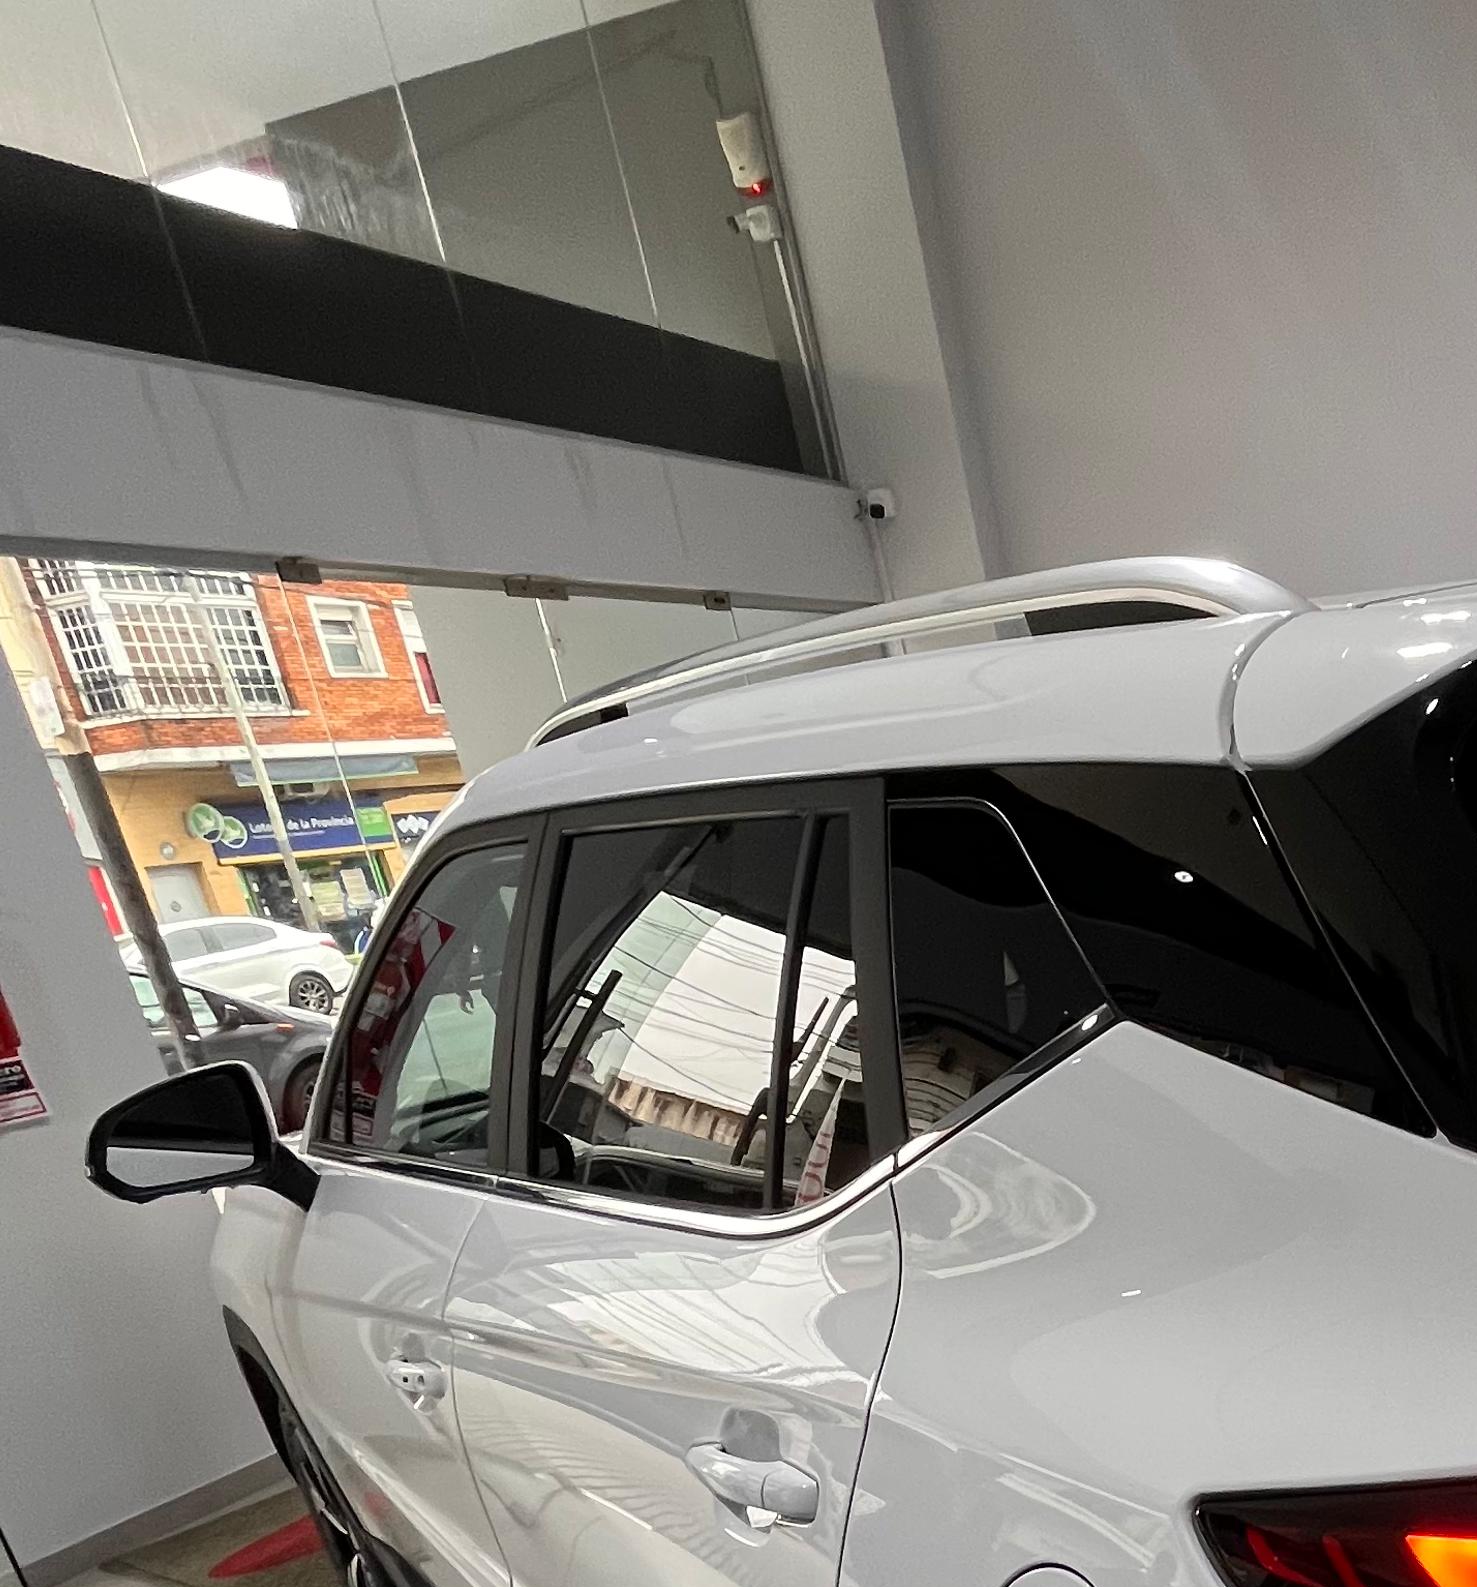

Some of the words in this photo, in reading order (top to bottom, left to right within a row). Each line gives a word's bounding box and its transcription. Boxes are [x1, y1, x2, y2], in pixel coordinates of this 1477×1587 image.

[286, 819, 300, 831] de
[299, 819, 311, 829] la
[310, 815, 355, 828] Provincia
